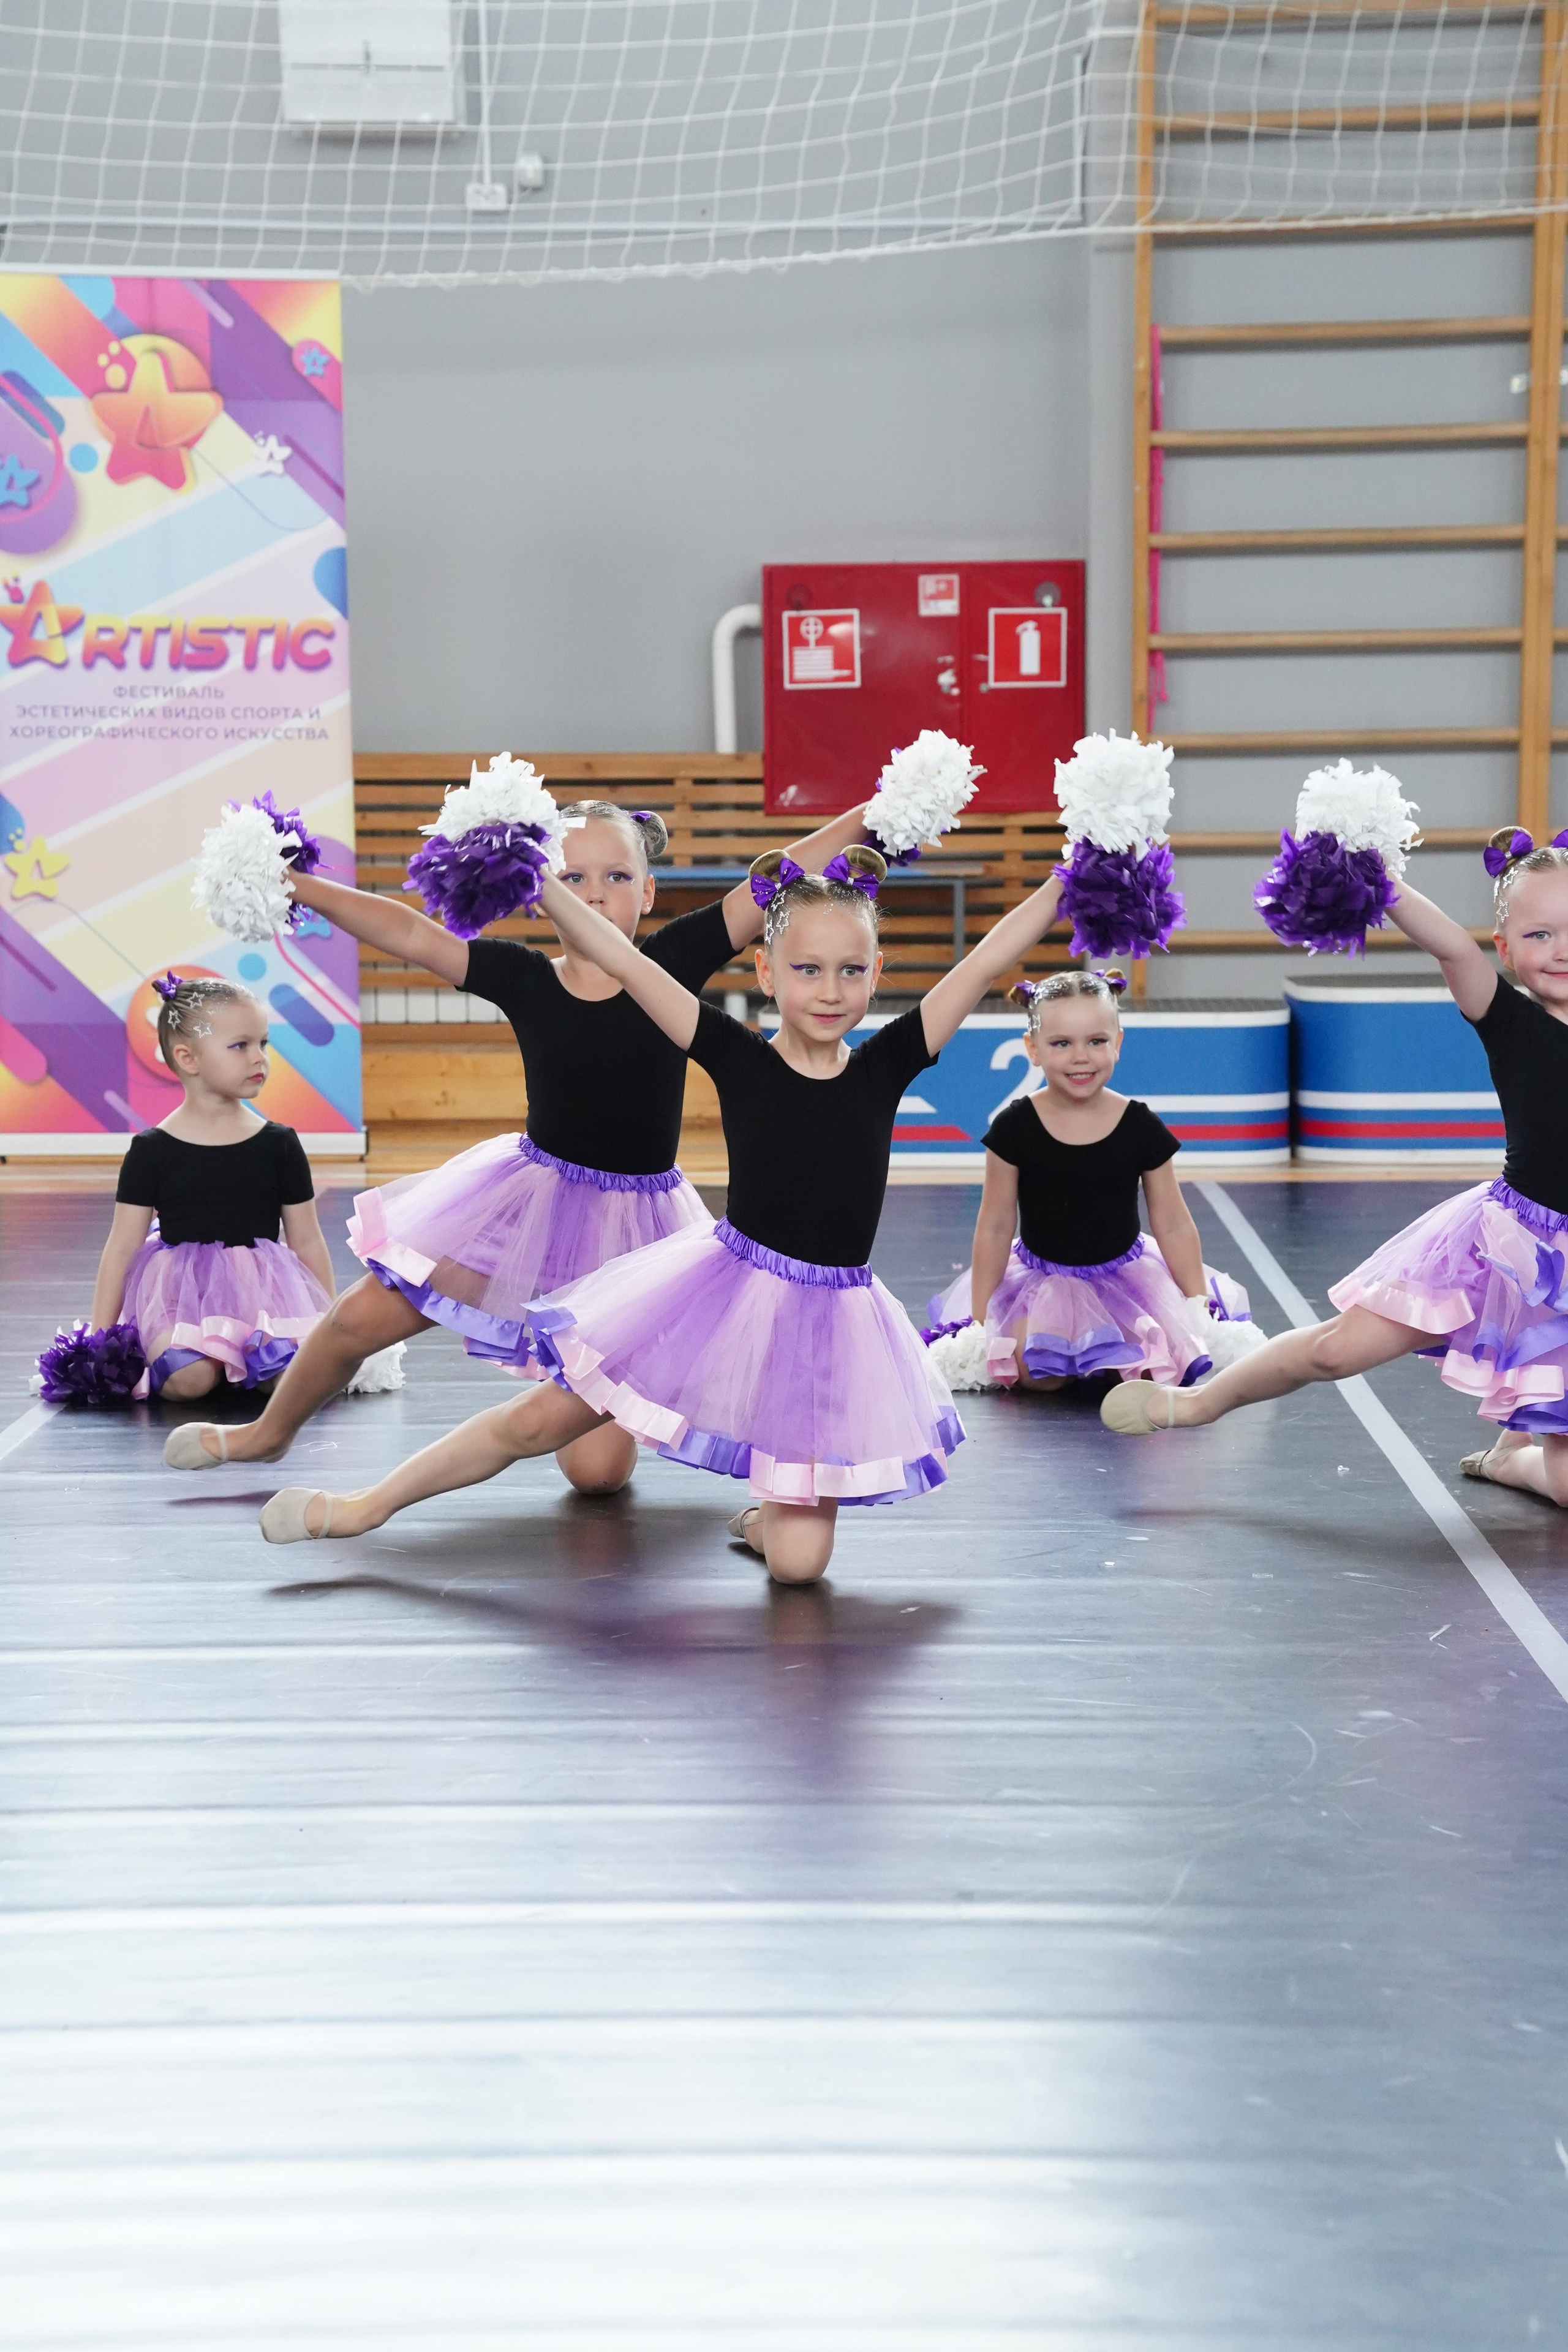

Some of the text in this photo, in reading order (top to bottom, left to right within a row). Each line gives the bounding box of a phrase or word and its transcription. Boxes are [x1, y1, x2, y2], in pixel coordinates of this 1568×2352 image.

[0, 580, 335, 671] ARTISTIC
[113, 685, 225, 699] ФЕСТИВАЛЬ
[15, 704, 321, 720] ЭСТЕТИЧЕСКИХ ВИДОВ СПОРТА И
[9, 725, 330, 741] ХОРЕОГРАФИЧЕСКОГО ИСКУССТВА
[987, 1037, 1047, 1126] 2
